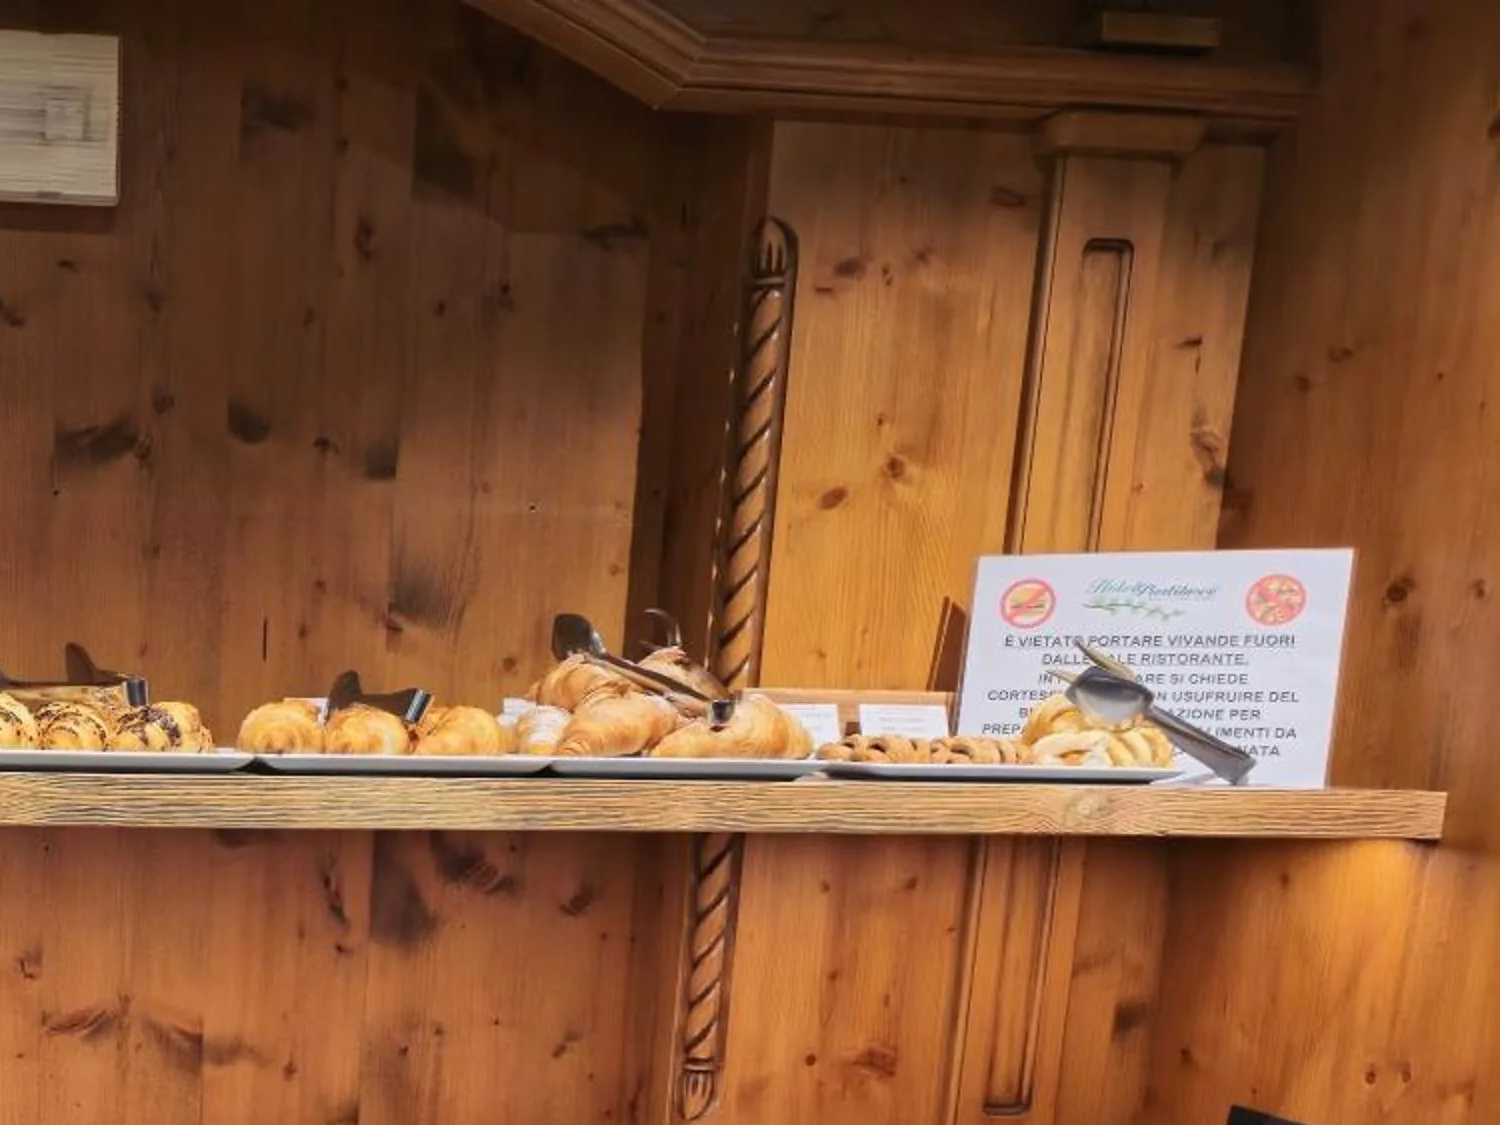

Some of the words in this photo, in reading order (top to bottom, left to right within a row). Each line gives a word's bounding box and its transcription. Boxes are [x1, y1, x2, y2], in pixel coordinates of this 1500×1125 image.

[1019, 635, 1084, 648] VIETATO
[1087, 635, 1163, 648] PORTARE
[1167, 635, 1241, 648] VIVANDE
[1243, 634, 1296, 647] FUORI
[1042, 653, 1090, 666] DALLE
[1140, 653, 1249, 666] RISTORANTE.
[1169, 673, 1185, 685] SI
[1188, 673, 1249, 685] CHIEDE
[1171, 691, 1265, 703] USUFRUIRE
[1268, 691, 1300, 703] DEL
[1229, 709, 1262, 721] PER
[1274, 727, 1298, 739] DA
